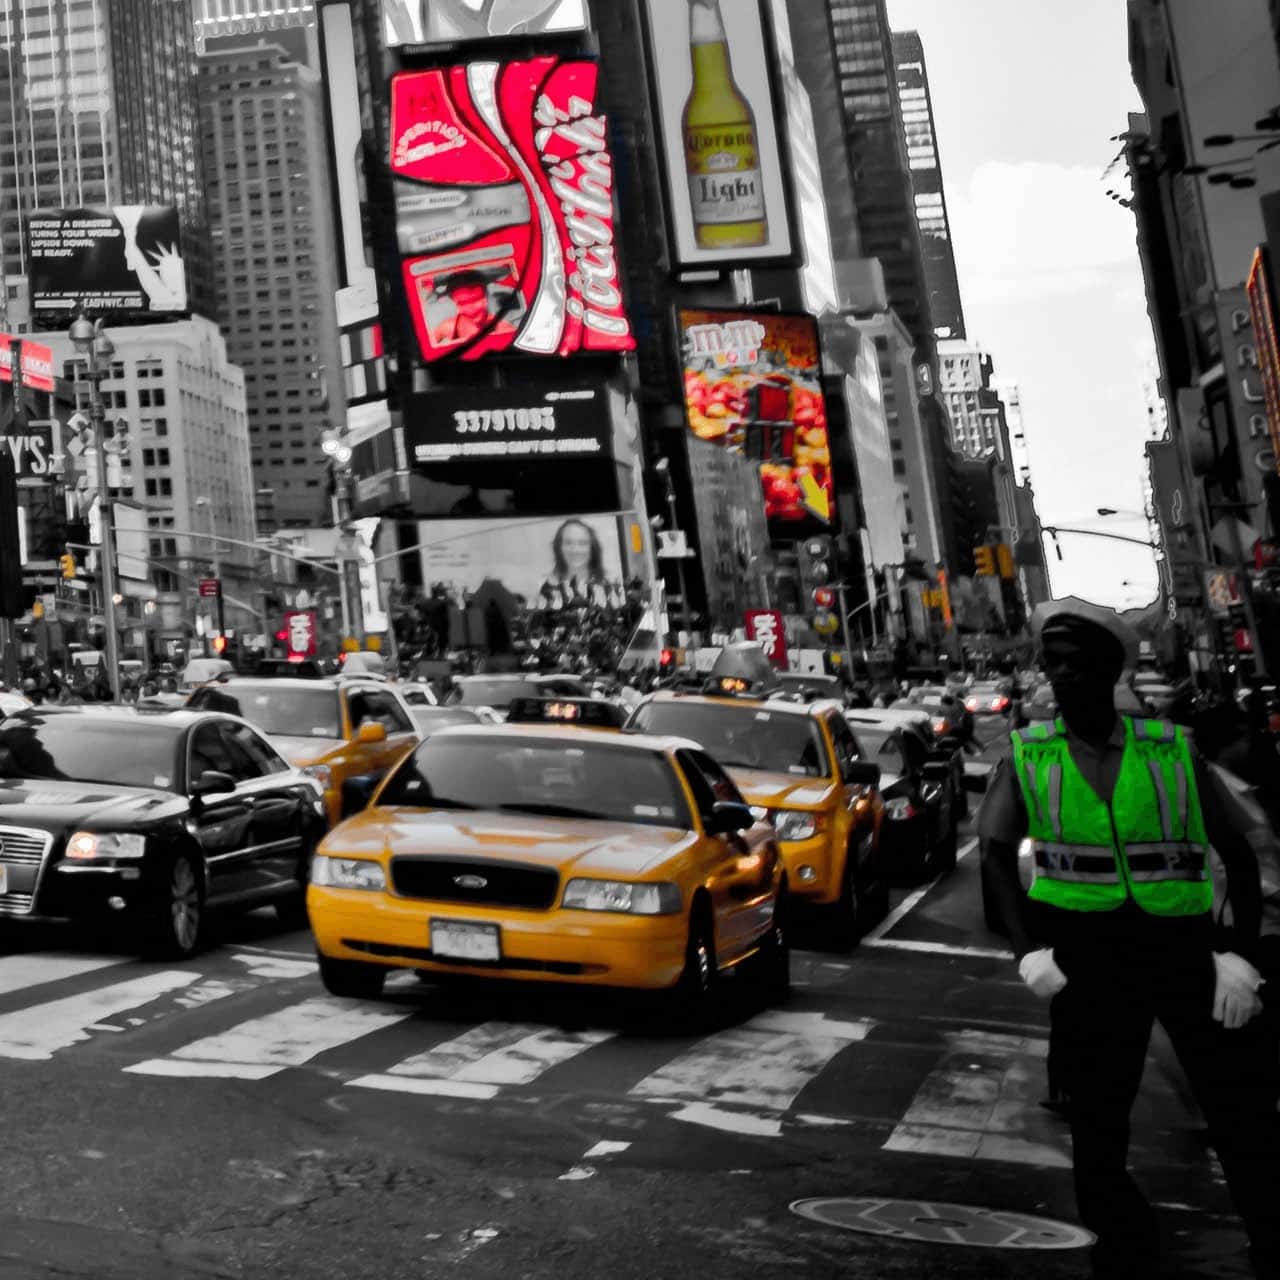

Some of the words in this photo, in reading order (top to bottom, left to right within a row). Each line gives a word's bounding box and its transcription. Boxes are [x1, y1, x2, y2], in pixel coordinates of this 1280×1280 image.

[699, 175, 755, 203] Light
[87, 228, 121, 238] WORLD
[31, 239, 61, 248] UPSIDE
